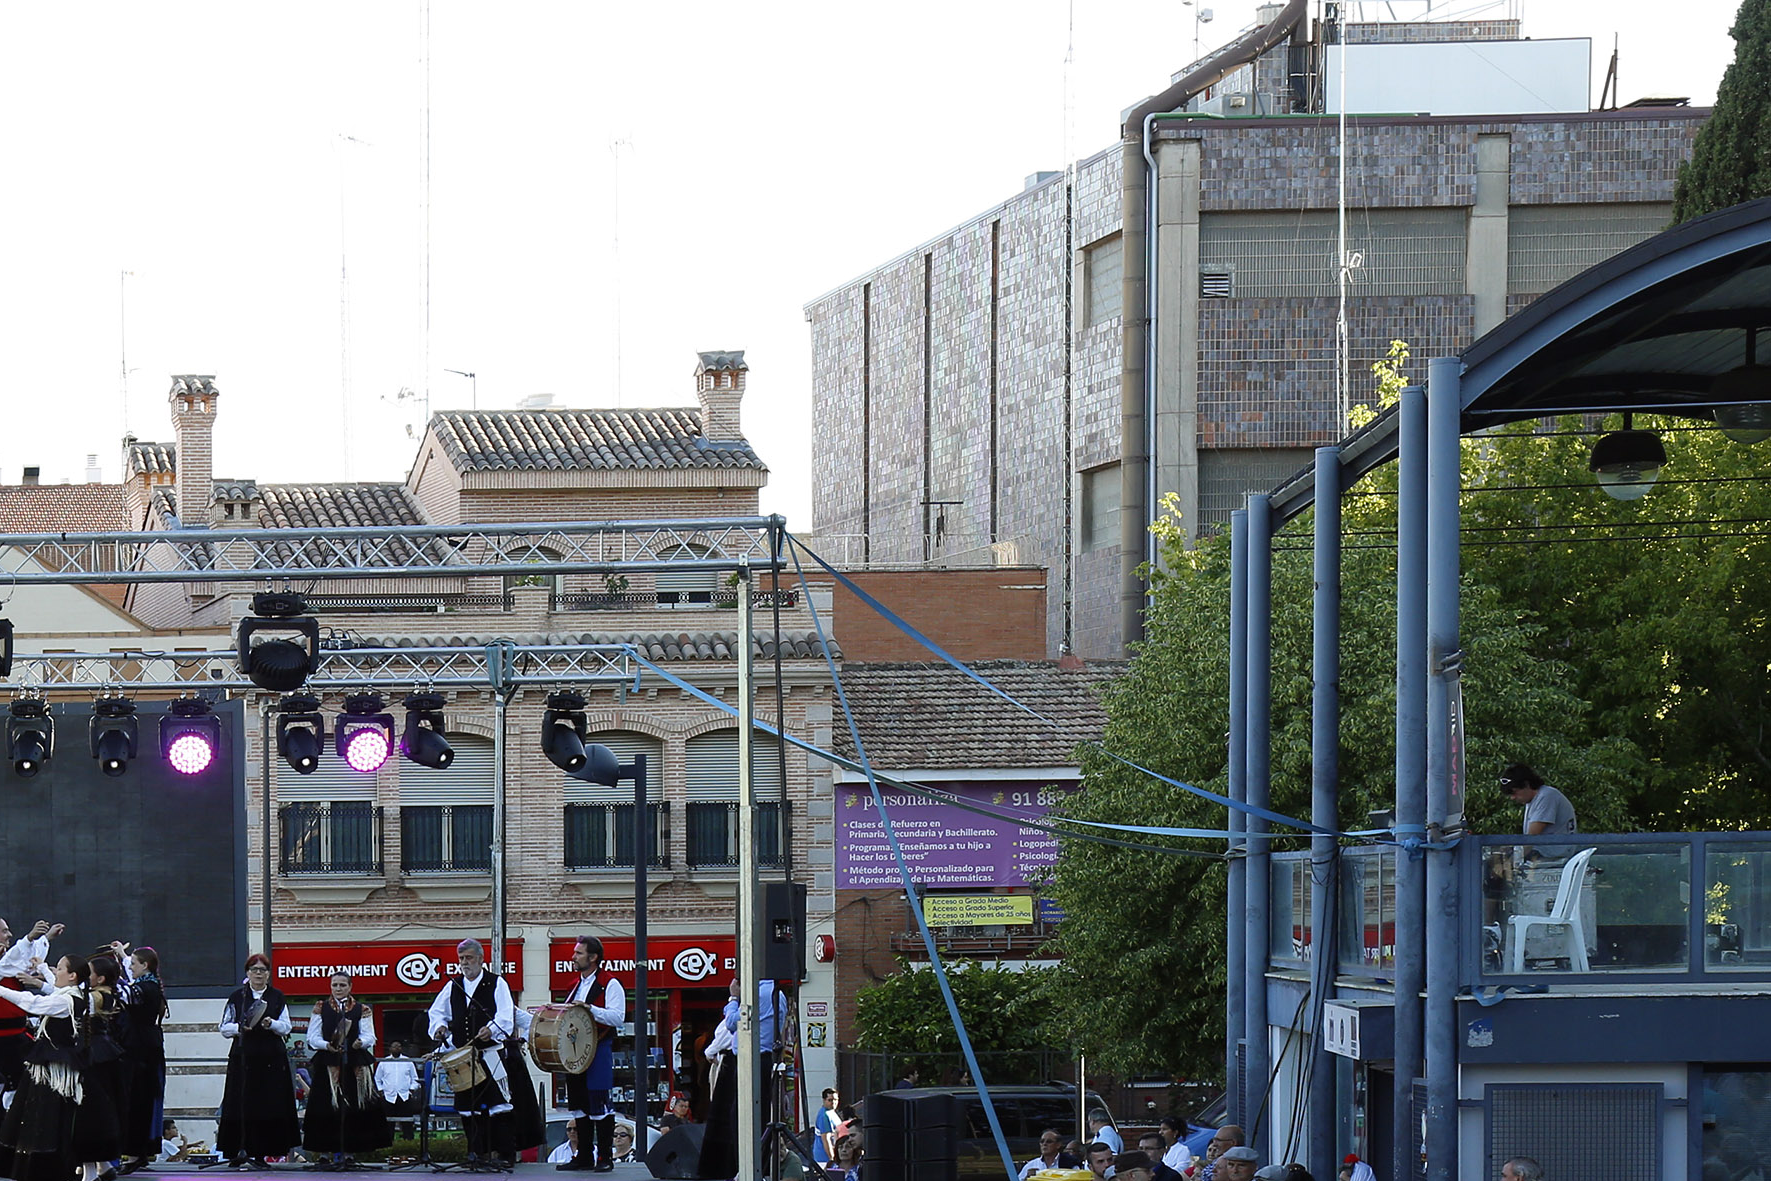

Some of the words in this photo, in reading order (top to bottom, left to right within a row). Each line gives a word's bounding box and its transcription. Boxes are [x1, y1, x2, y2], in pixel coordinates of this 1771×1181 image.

[1012, 792, 1032, 806] 91
[849, 821, 876, 829] Clases
[890, 820, 928, 828] Refuerzo
[849, 830, 888, 839] Primaria,
[890, 829, 937, 838] ecundaria
[937, 830, 944, 838] y
[945, 828, 998, 837] Bachillerato.
[1019, 827, 1044, 836] Niños
[956, 842, 966, 850] tu
[967, 841, 984, 852] hijo
[1019, 840, 1059, 849] Logopedi
[849, 853, 874, 861] Hacer
[875, 853, 888, 861] los
[890, 851, 929, 861] Dberes"
[849, 865, 884, 875] Método
[915, 864, 978, 874] Personalizado
[979, 866, 994, 874] para
[849, 875, 858, 883] el
[859, 875, 904, 885] Aprendizaj
[910, 875, 921, 883] de
[923, 875, 935, 883] las
[936, 873, 994, 883] Matemáticas.
[987, 904, 1015, 912] Superior
[966, 911, 994, 920] Mayores
[278, 964, 388, 978] ENTERTAINMENT
